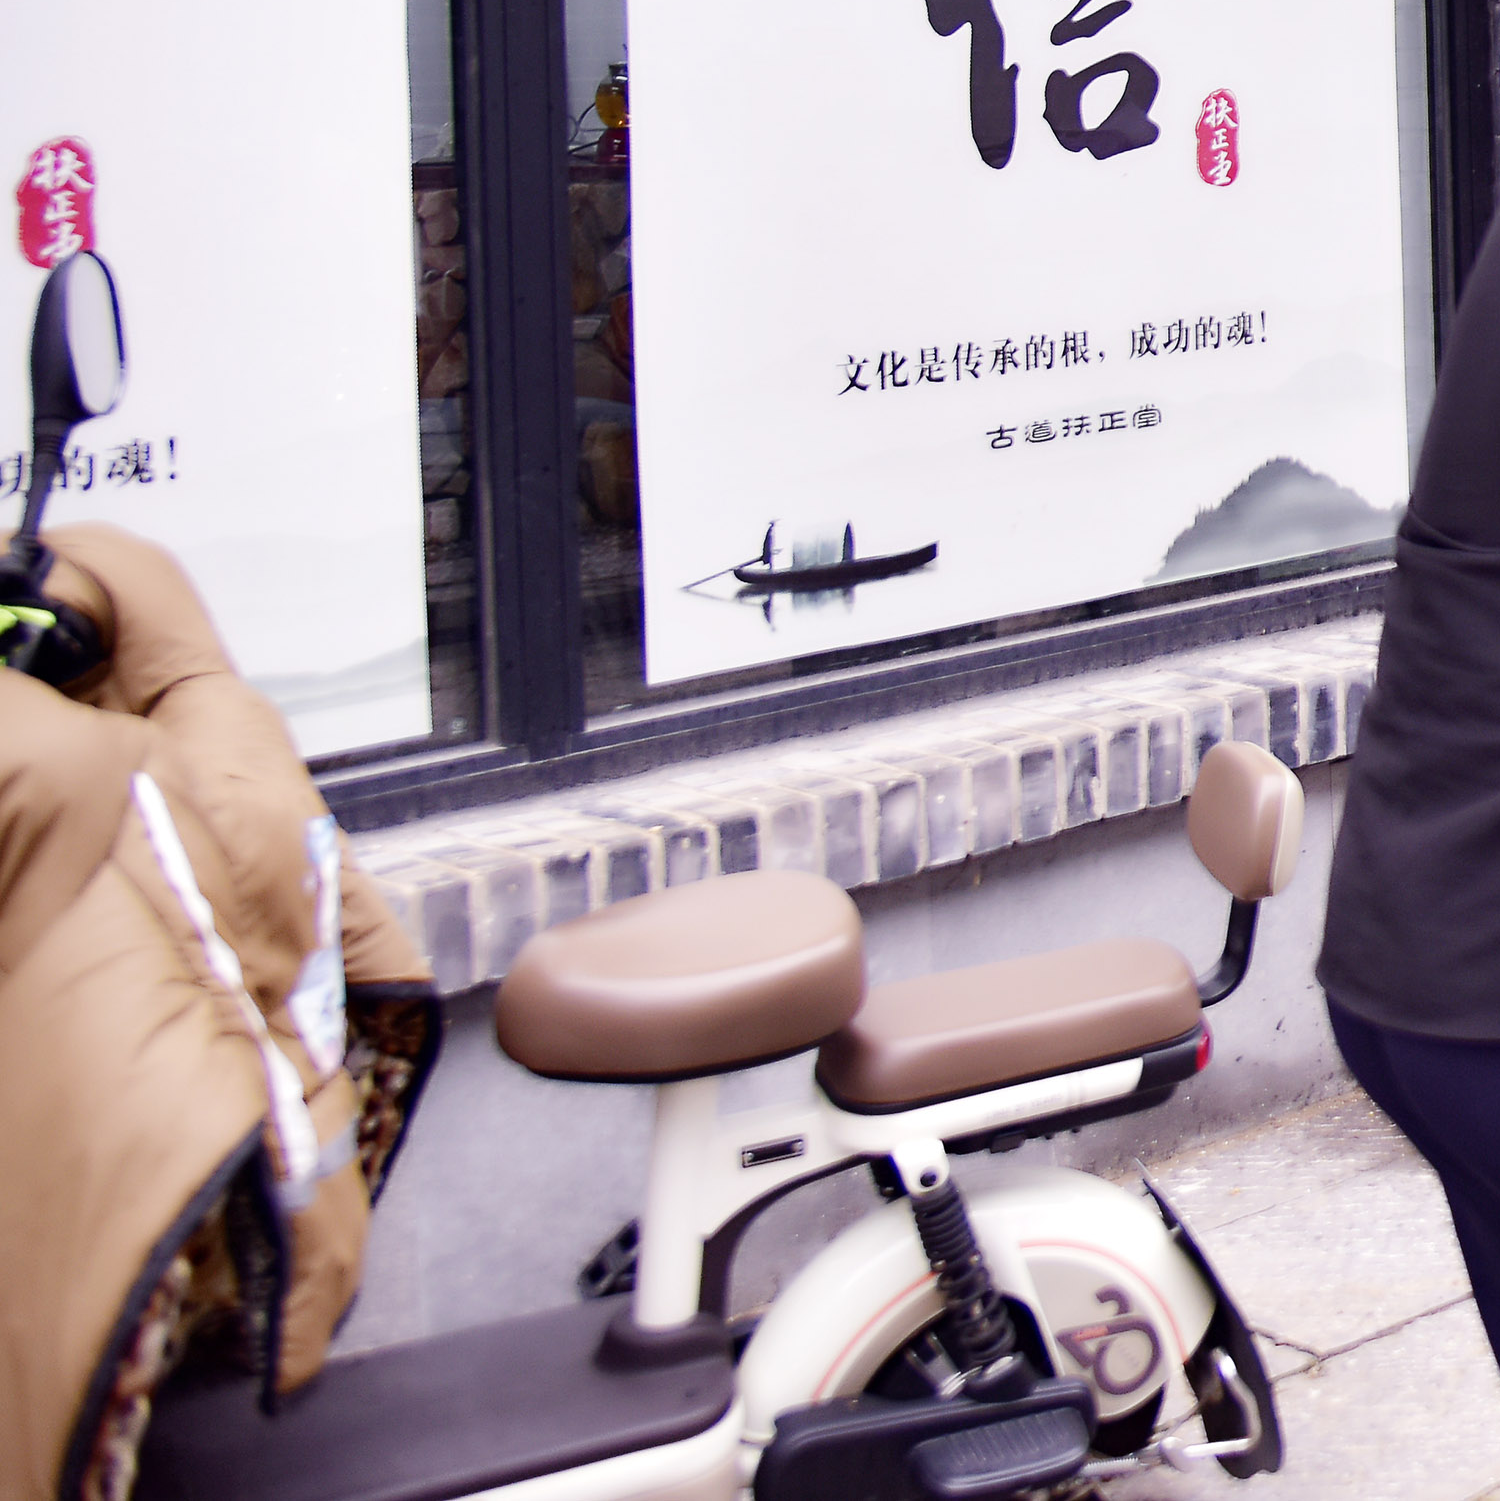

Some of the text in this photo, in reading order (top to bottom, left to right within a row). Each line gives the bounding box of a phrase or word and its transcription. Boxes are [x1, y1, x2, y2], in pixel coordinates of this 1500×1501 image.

[985, 403, 1163, 450] 古道扶正堂
